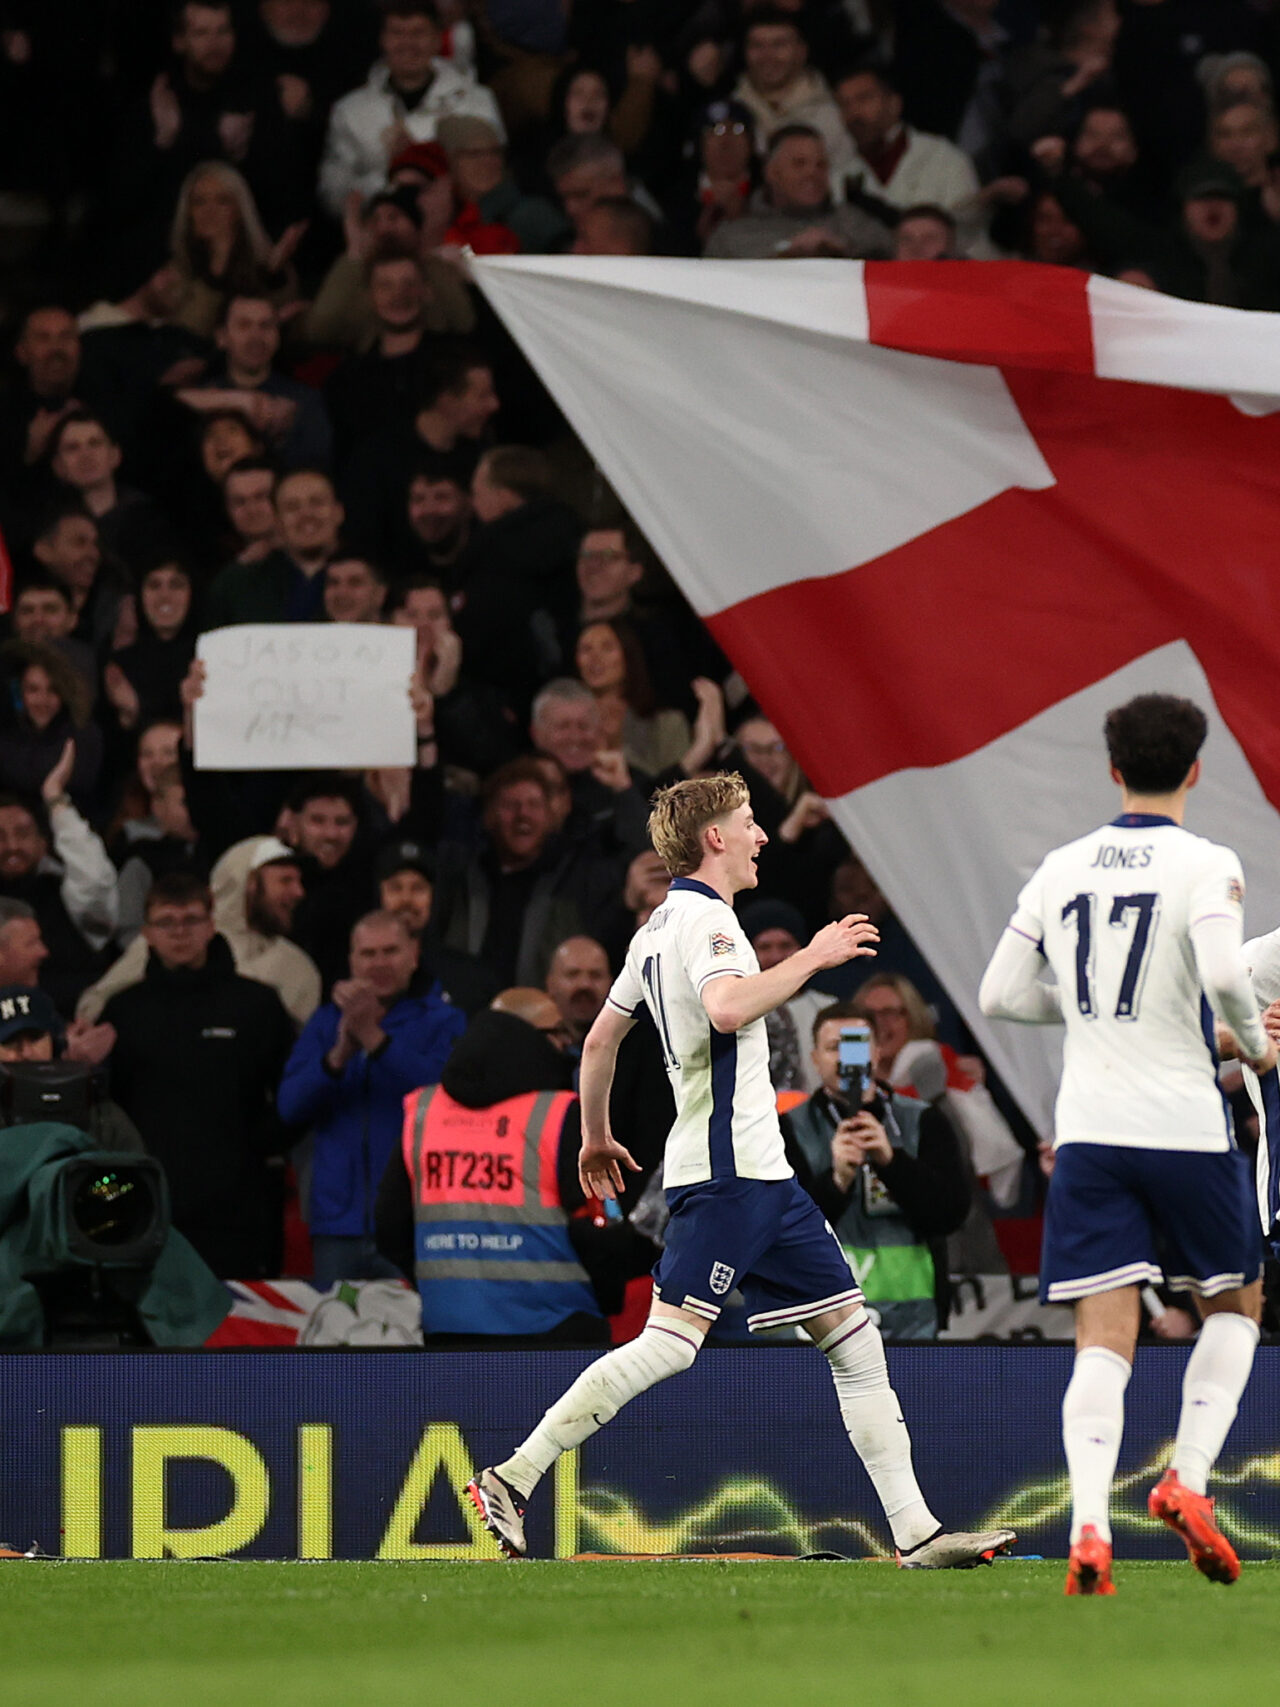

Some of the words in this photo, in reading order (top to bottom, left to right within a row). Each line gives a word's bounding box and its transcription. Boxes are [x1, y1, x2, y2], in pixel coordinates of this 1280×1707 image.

[222, 635, 386, 671] JASON
[247, 675, 357, 708] OUT
[1090, 845, 1154, 869] JONES
[1062, 891, 1162, 1021] 17
[426, 1151, 515, 1191] RT235
[458, 1233, 479, 1250] TO
[480, 1233, 524, 1250] HELP
